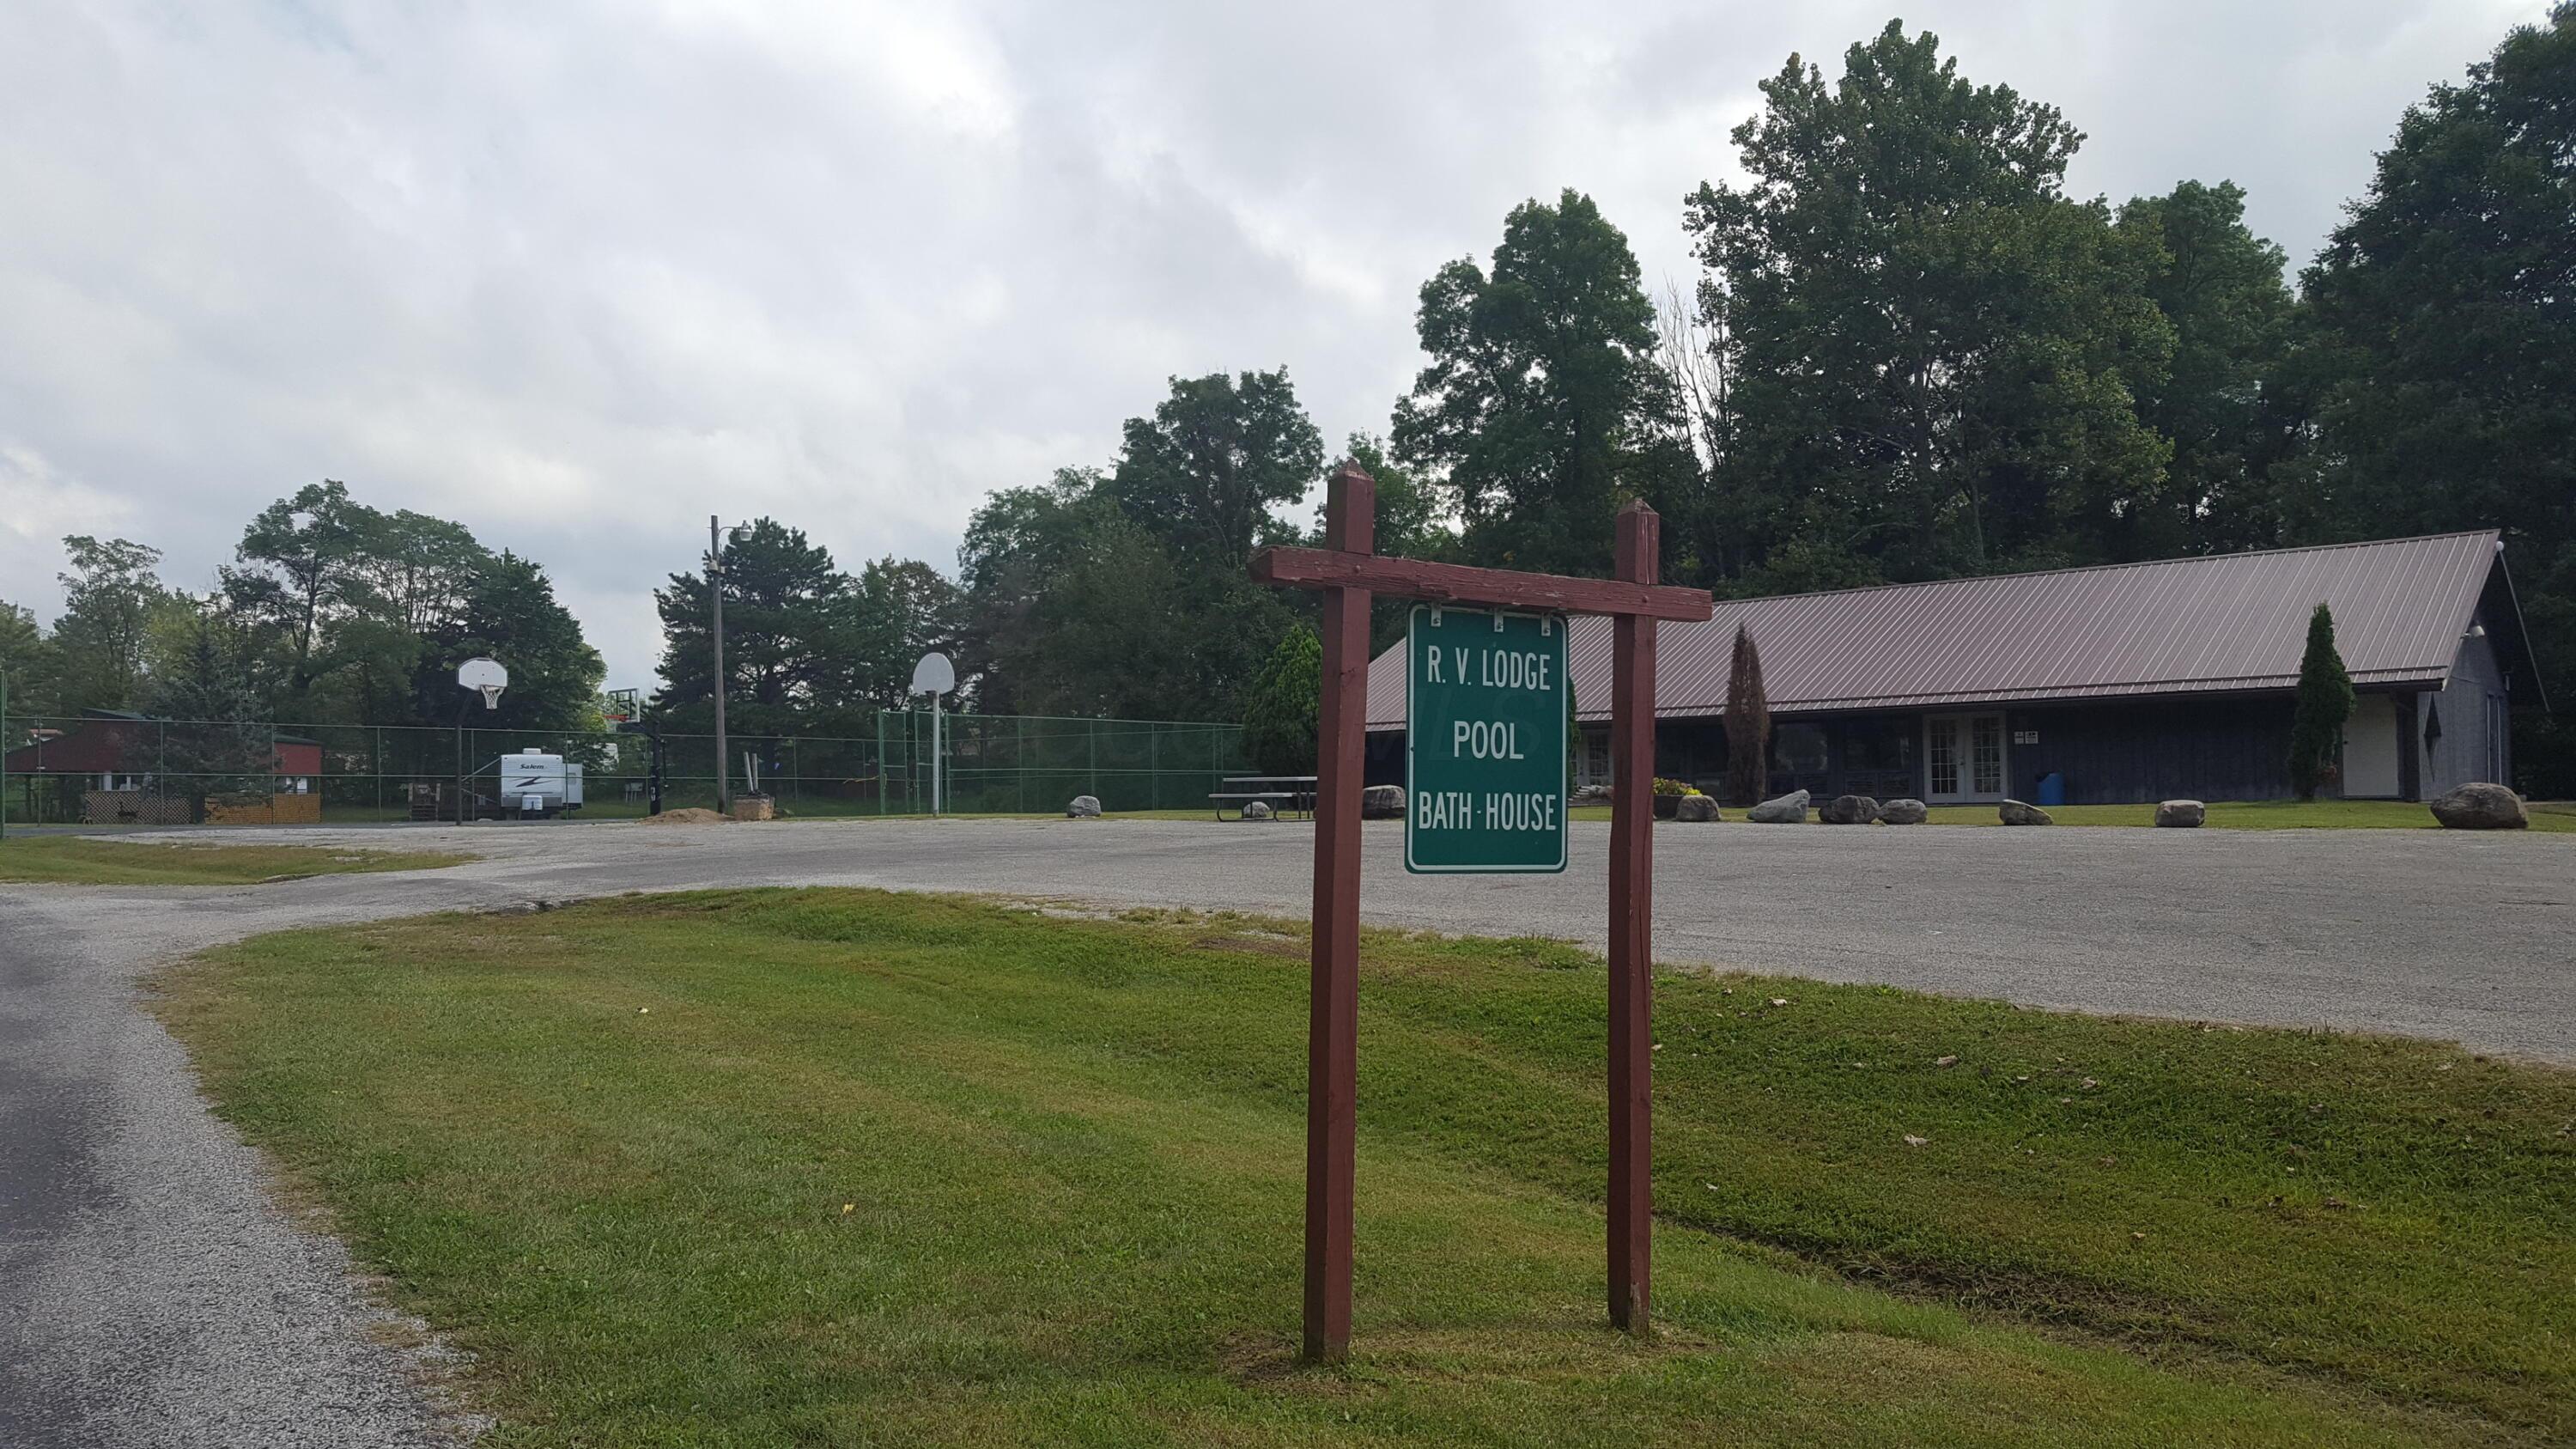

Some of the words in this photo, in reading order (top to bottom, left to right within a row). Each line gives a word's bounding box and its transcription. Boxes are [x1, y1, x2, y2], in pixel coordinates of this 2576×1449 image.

[1428, 645, 1446, 683] R.
[1455, 648, 1471, 685] V.
[1482, 649, 1551, 690] LODGE
[1454, 721, 1524, 759] POOL
